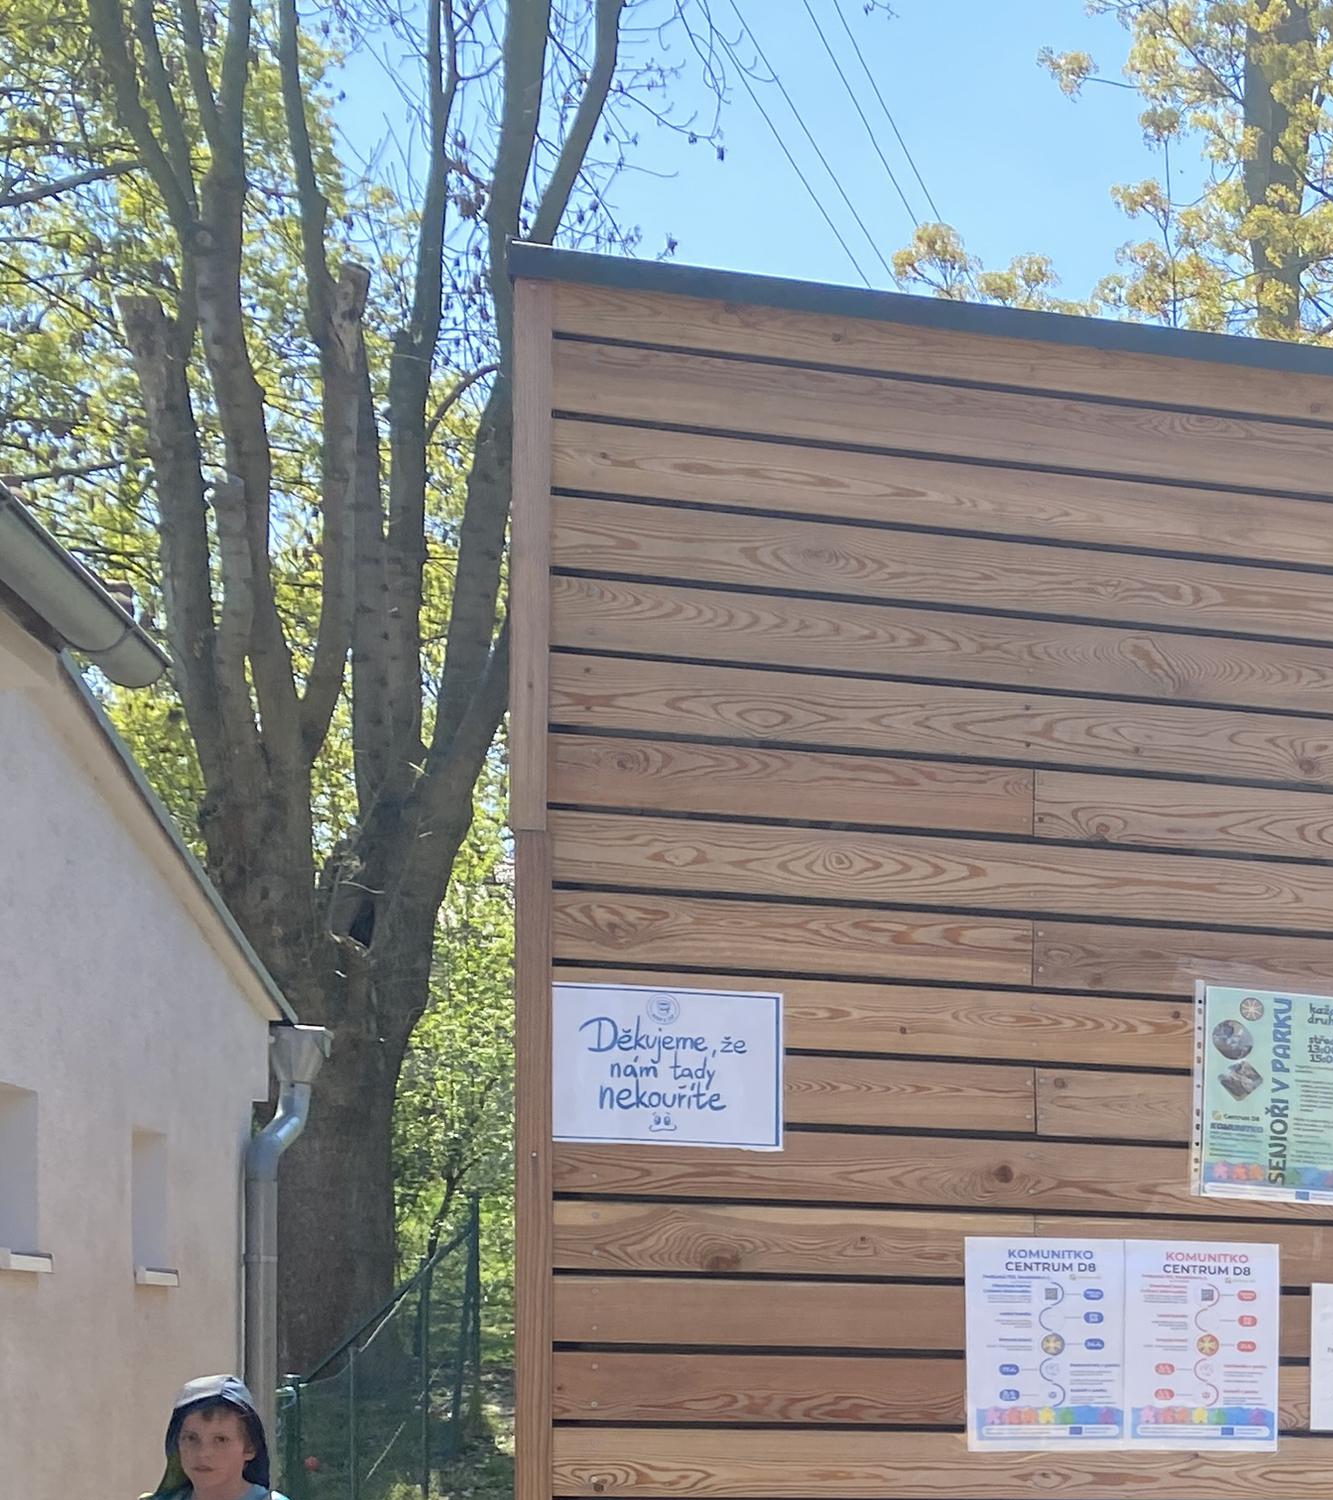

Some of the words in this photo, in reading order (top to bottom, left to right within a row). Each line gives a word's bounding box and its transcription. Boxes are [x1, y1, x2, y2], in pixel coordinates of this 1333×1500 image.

[1272, 997, 1293, 1073] PARKU
[720, 1036, 748, 1053] že
[610, 1056, 658, 1078] nám
[670, 1050, 716, 1090] tady
[1271, 1078, 1290, 1093] V
[1265, 1098, 1289, 1185] SENIOŘI
[1008, 1249, 1094, 1260] KOMUNITKO
[1166, 1252, 1249, 1264] KOMUNITKO
[1005, 1261, 1073, 1272] CENTRUM
[1078, 1263, 1096, 1272] D8
[1163, 1264, 1229, 1276] CENTRUM
[1233, 1266, 1251, 1276] D8
